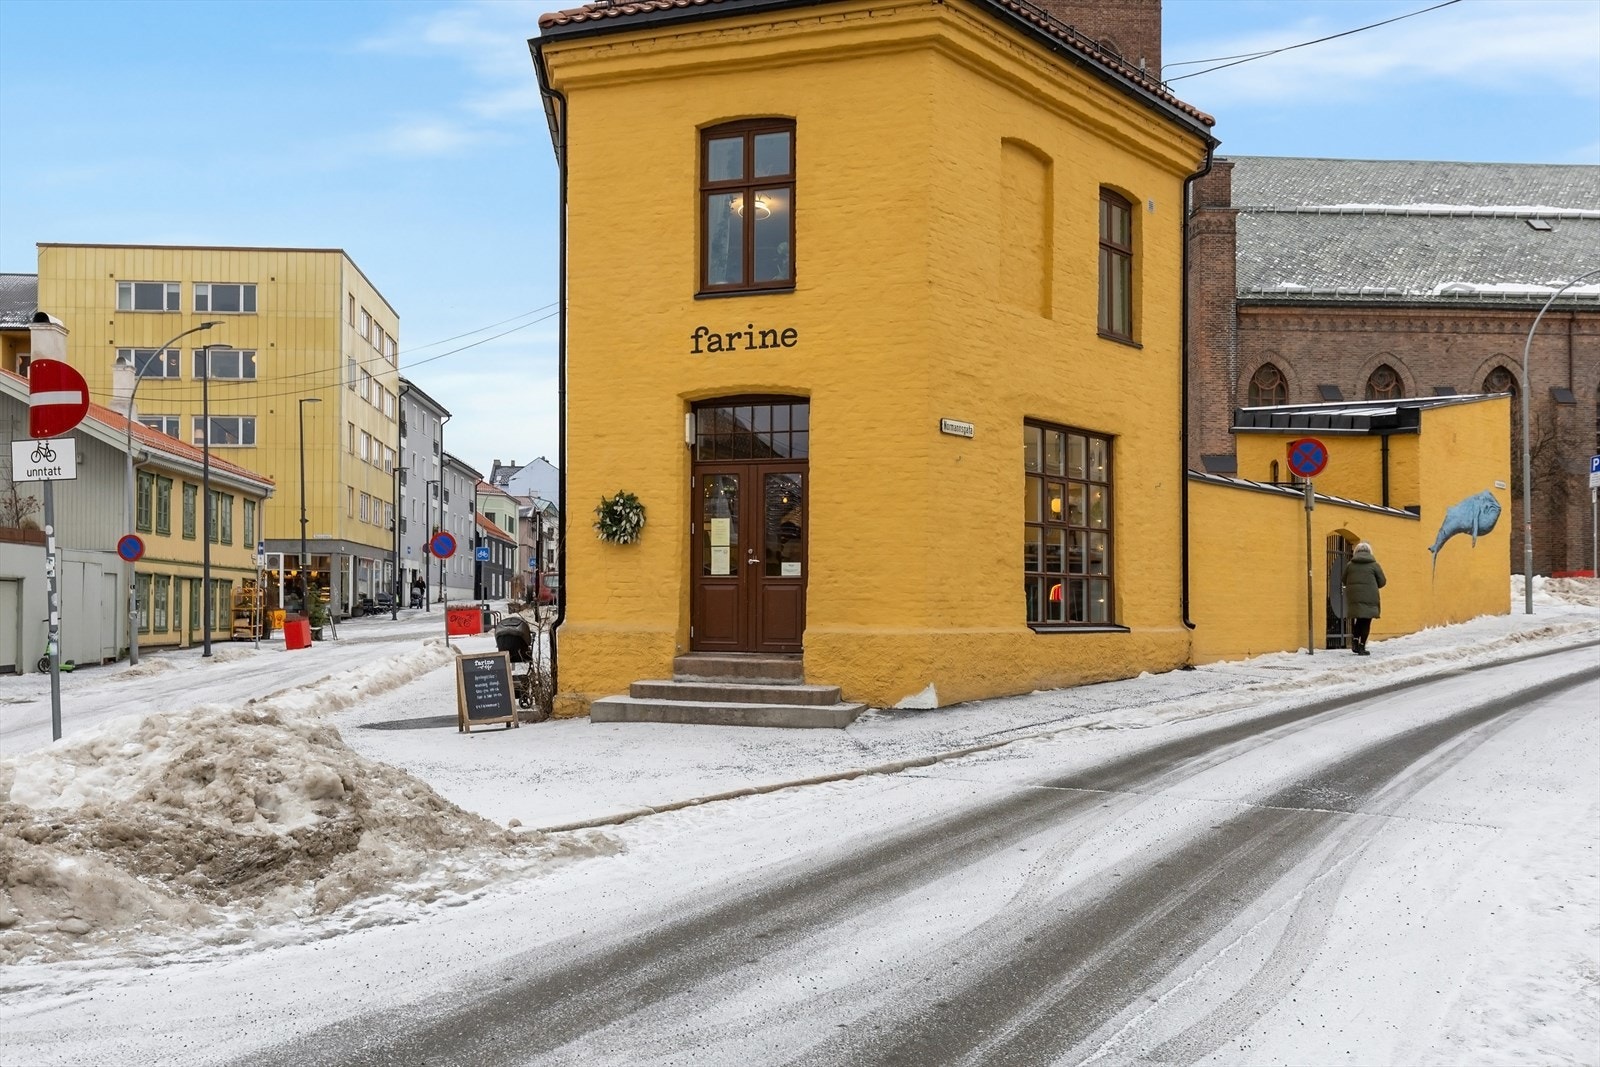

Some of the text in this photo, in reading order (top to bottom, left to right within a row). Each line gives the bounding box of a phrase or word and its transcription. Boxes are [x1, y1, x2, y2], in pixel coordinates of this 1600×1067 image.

[690, 323, 798, 354] farine
[1592, 458, 1600, 471] P
[26, 466, 62, 477] unntatt
